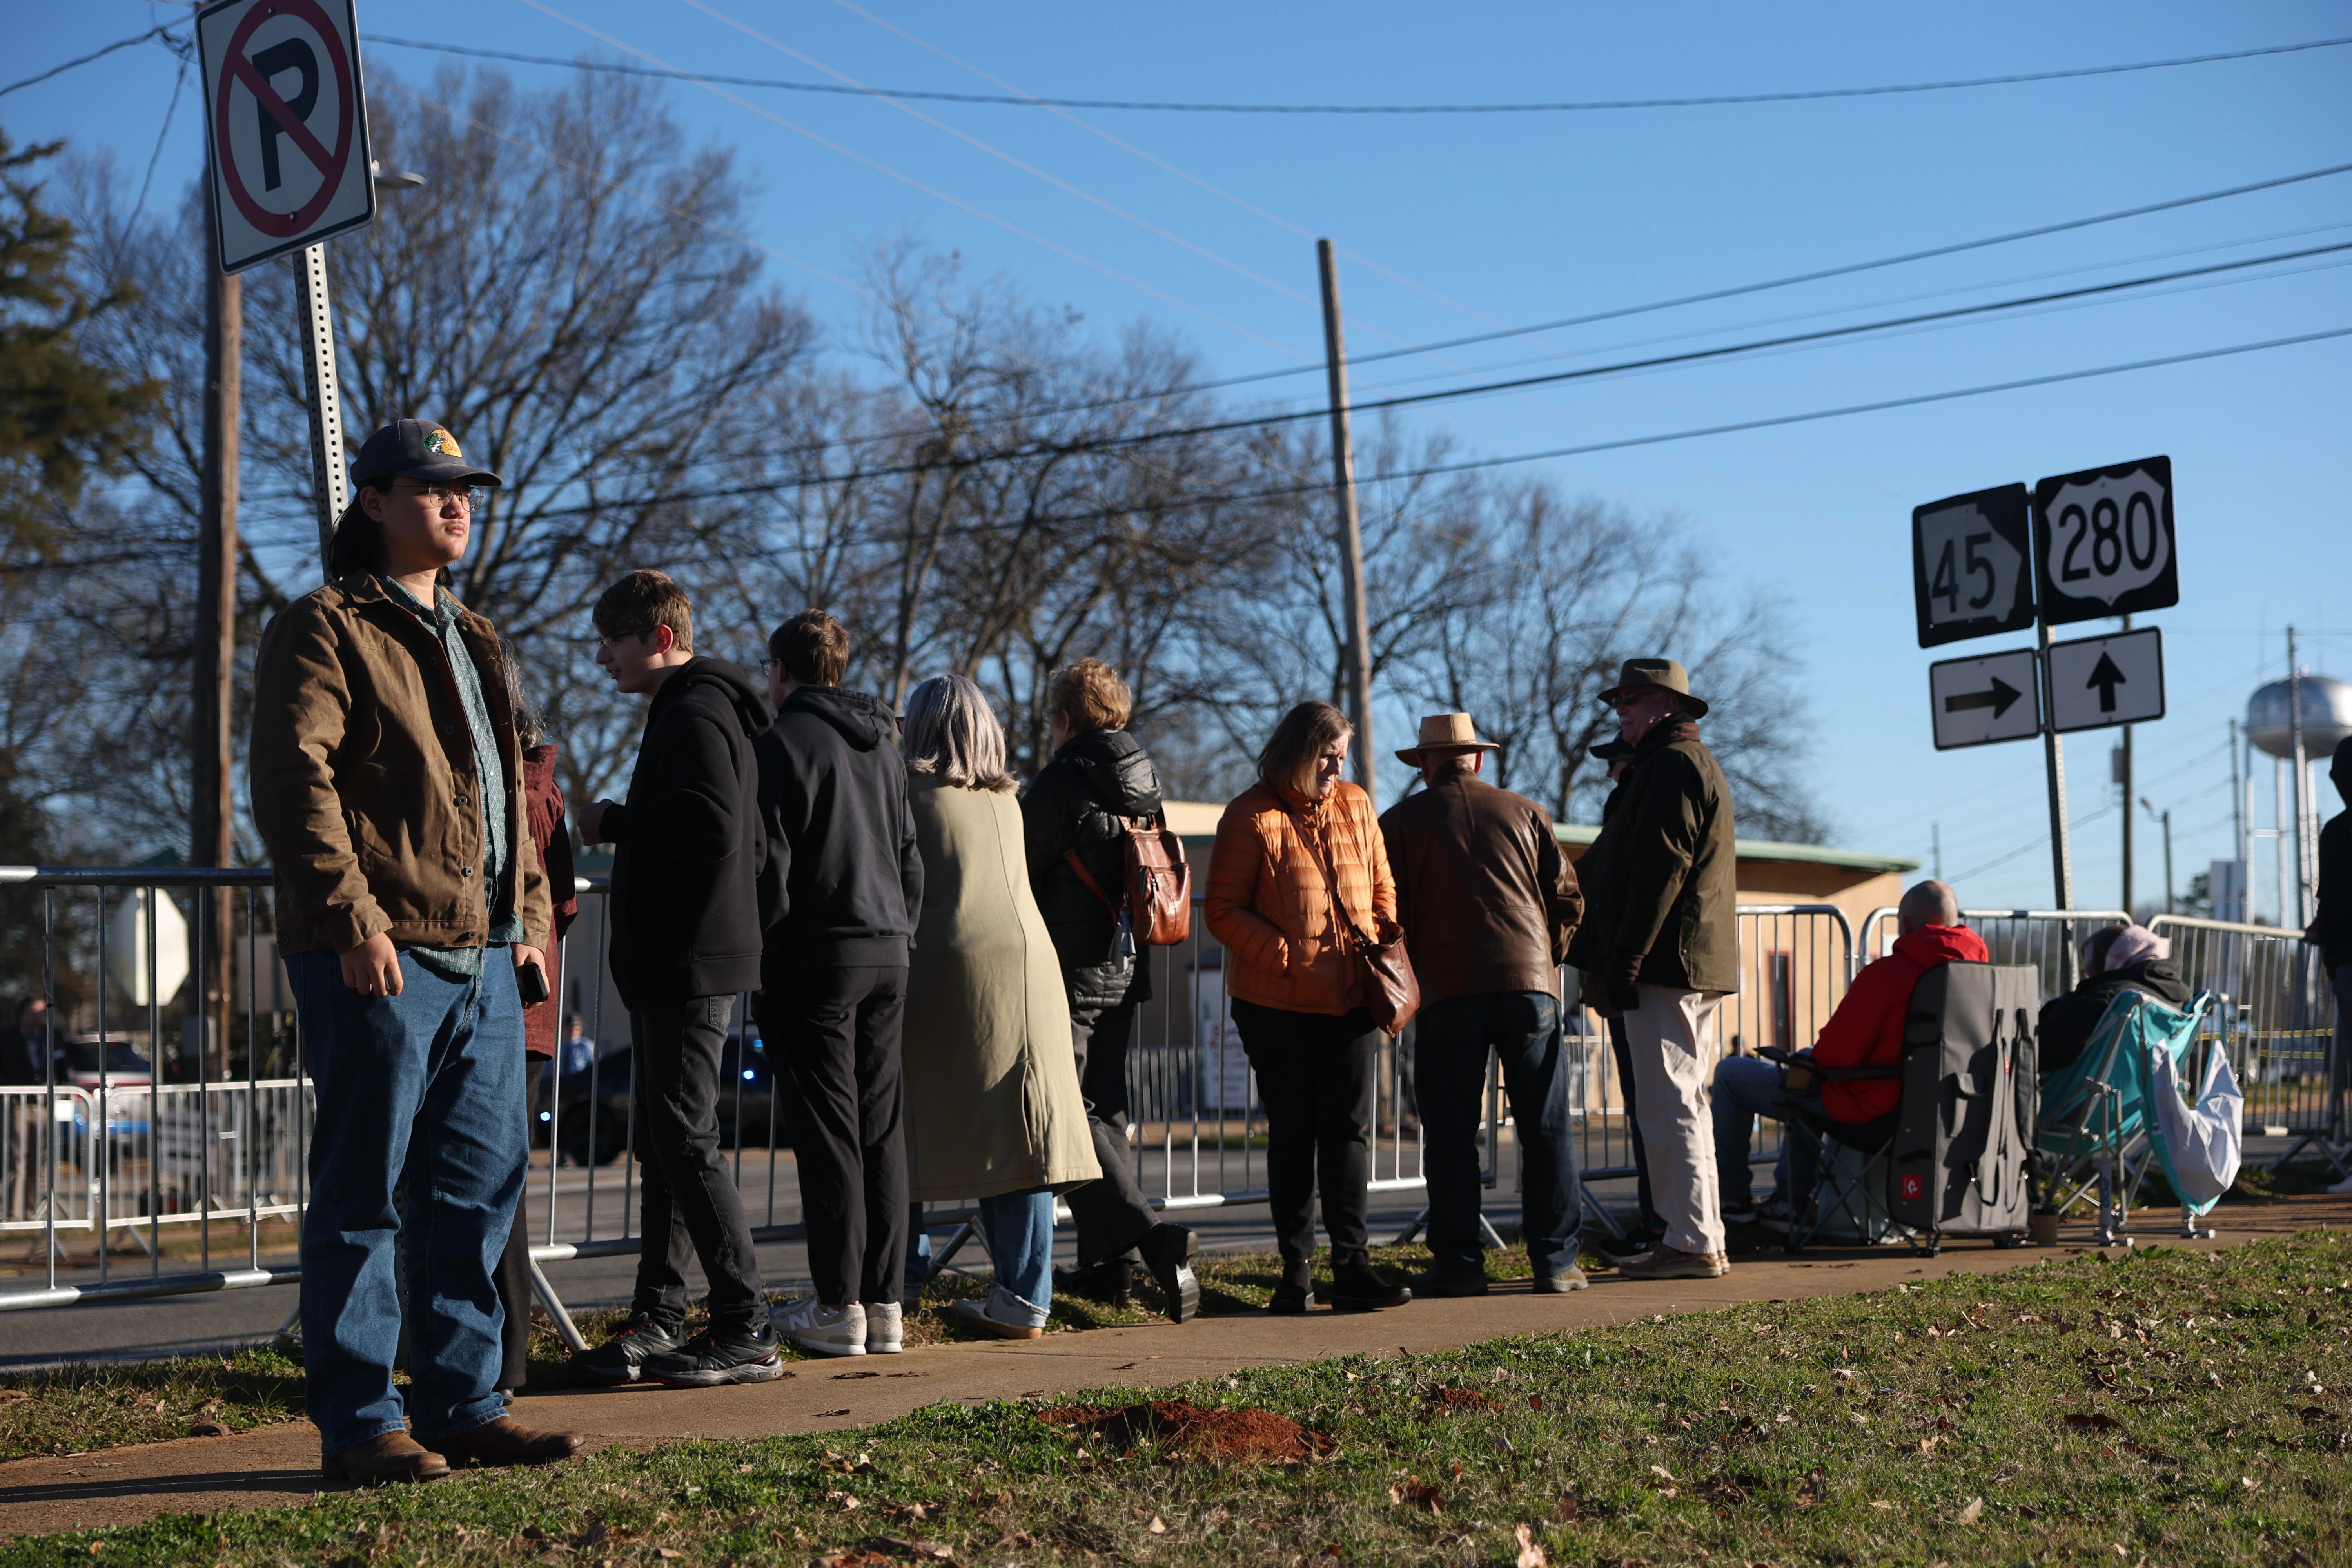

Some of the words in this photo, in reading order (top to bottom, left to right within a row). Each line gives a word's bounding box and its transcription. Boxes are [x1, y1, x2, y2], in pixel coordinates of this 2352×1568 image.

[252, 38, 319, 192] P
[1932, 532, 1996, 613] 45
[2058, 490, 2157, 583] 280
[789, 1311, 810, 1330] N
